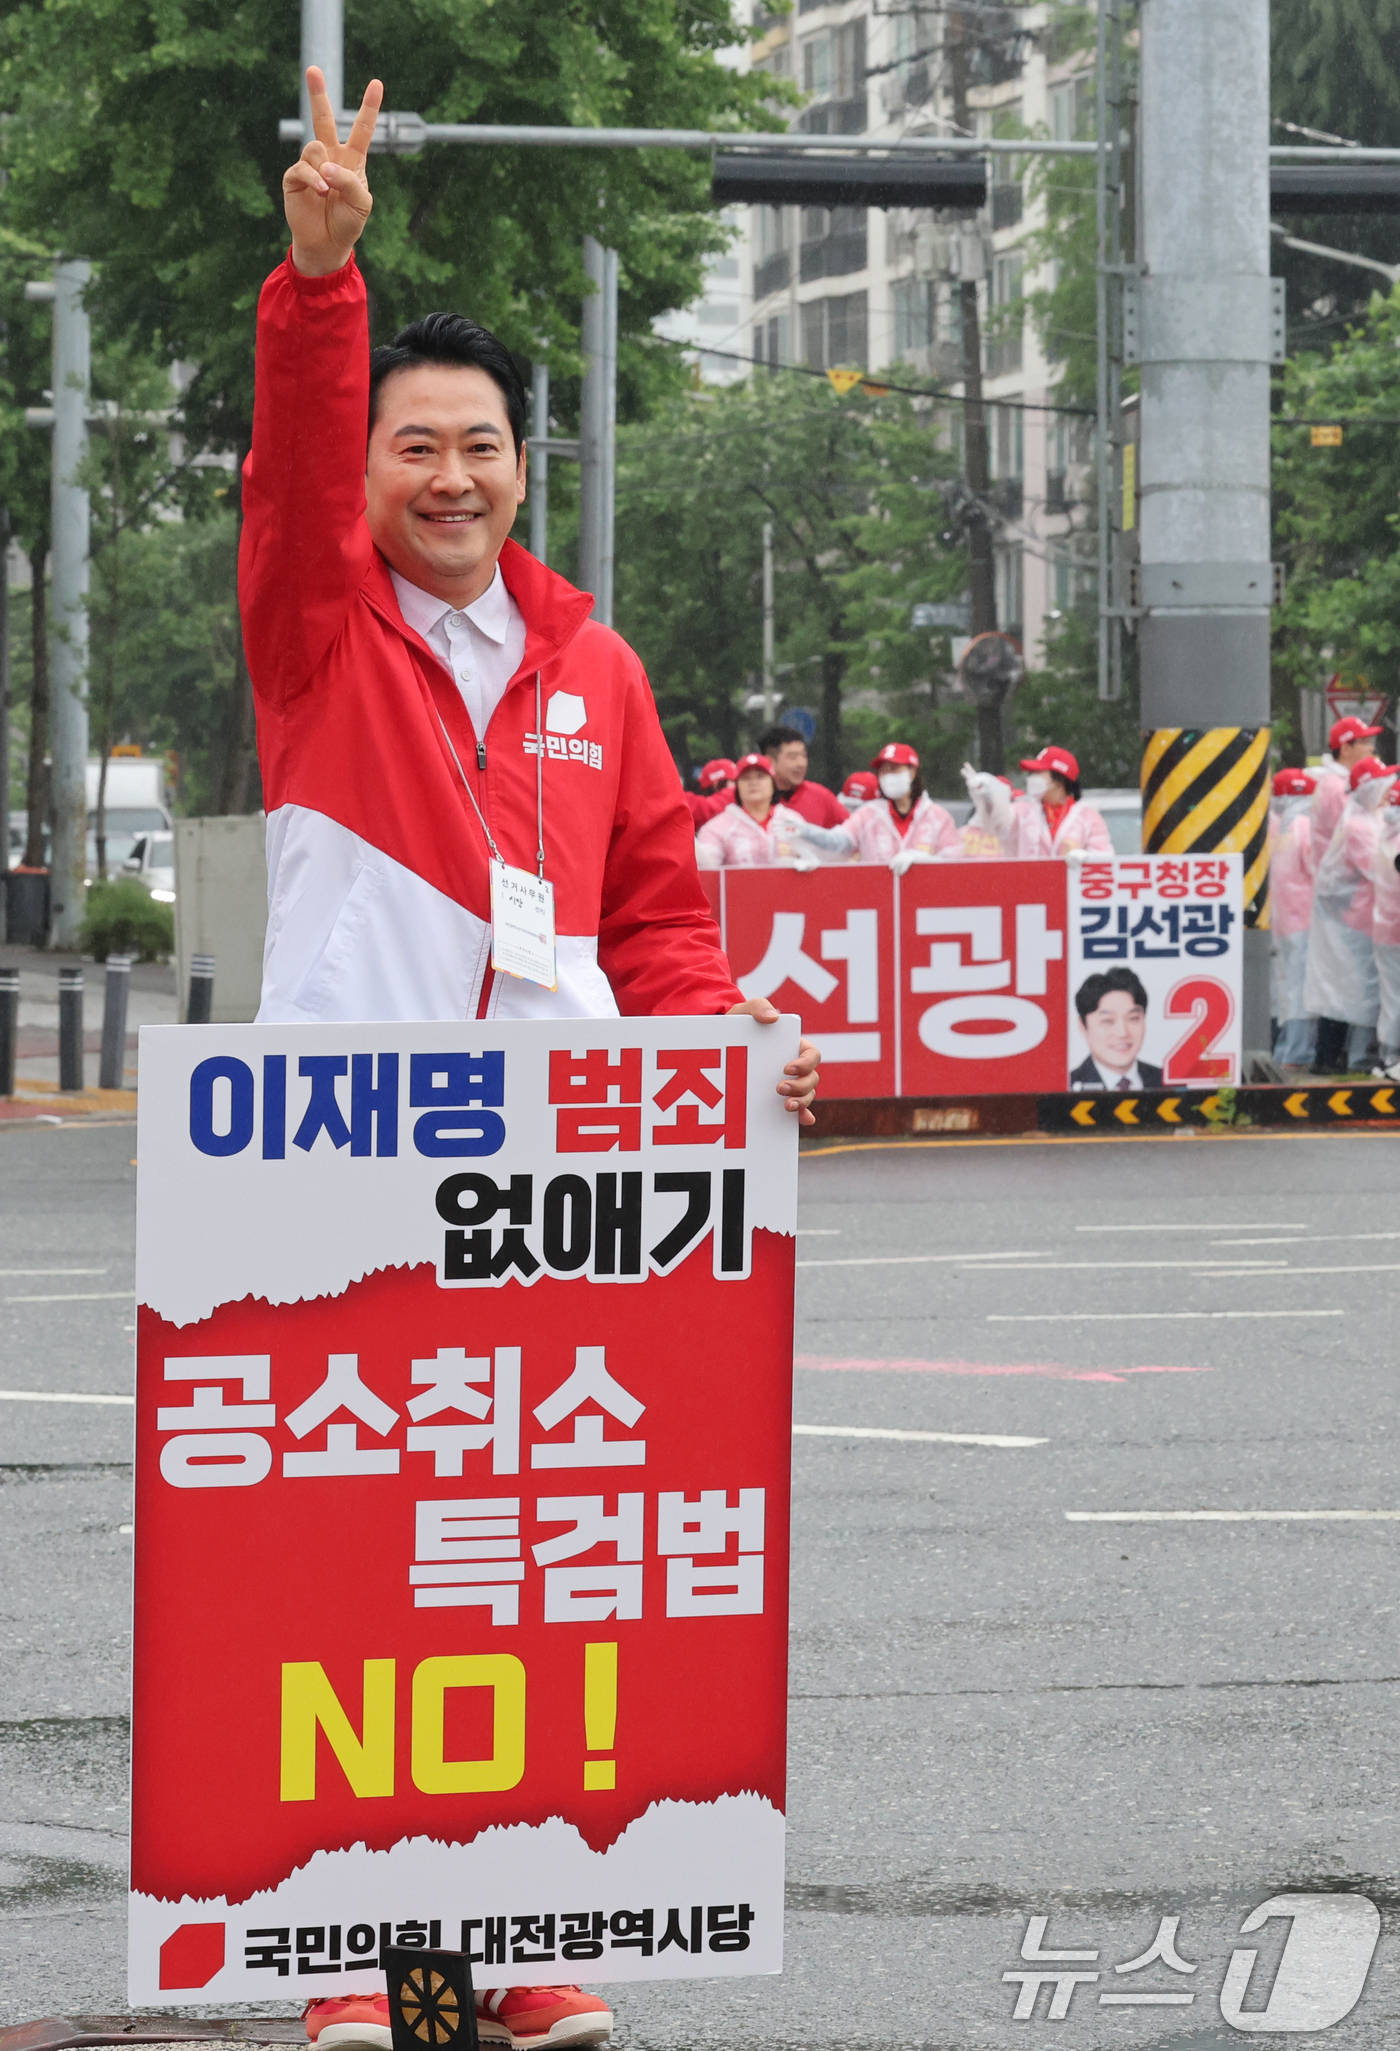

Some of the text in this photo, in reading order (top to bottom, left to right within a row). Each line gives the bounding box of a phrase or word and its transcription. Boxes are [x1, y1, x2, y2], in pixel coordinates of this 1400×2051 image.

[523, 732, 603, 771] 국민의힘
[502, 878, 545, 903] 선거사무원
[1080, 861, 1230, 900] 중구청장
[1080, 904, 1235, 959] 김선광
[1162, 975, 1236, 1086] 2
[190, 1045, 748, 1160] 이재명 범죄
[435, 1168, 746, 1279] 없애기
[156, 1345, 647, 1488] 공소취소
[408, 1487, 766, 1626] 특검법
[280, 1653, 526, 1802] NO
[461, 1903, 755, 1966] 대전광역시당
